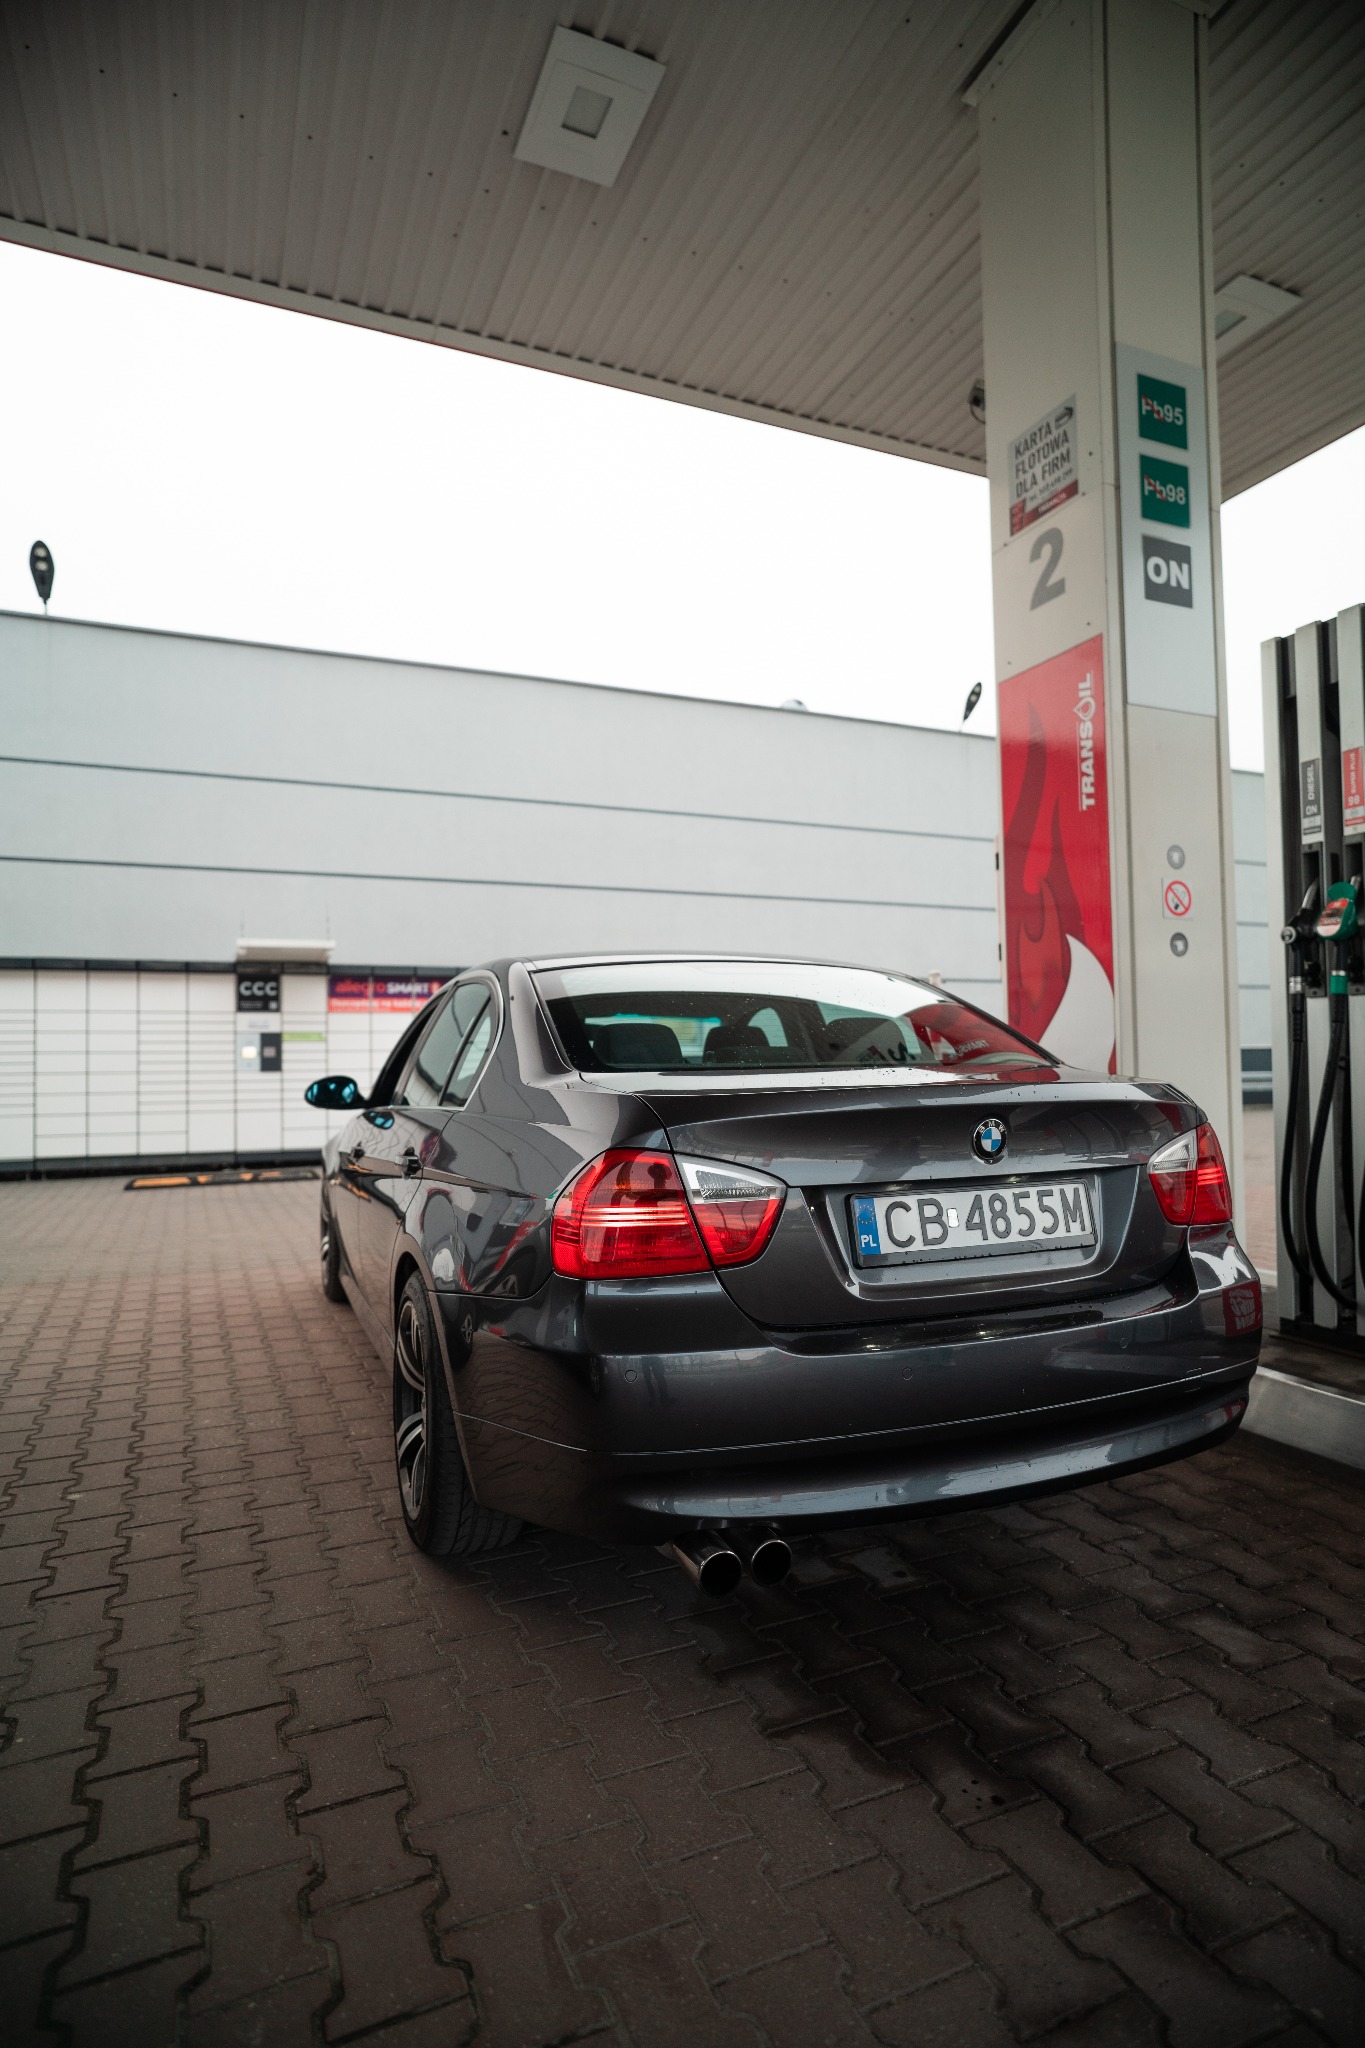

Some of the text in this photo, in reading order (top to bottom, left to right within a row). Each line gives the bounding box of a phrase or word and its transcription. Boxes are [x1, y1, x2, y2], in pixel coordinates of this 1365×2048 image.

[1141, 395, 1184, 426] Pb95
[1015, 421, 1052, 459] KARTA
[1016, 429, 1069, 479] FLOTOWA
[1016, 473, 1038, 498] DLA
[1042, 447, 1070, 480] FIRM
[1144, 475, 1186, 505] Pb98
[1029, 527, 1066, 611] 2
[1146, 556, 1190, 590] ON
[1073, 672, 1097, 811] TRANSOIL
[1306, 763, 1315, 801] DIESEL
[239, 981, 278, 996] CCC
[978, 1120, 1006, 1133] BMW
[885, 1187, 1086, 1248] CB 4855M
[861, 1234, 877, 1248] PL
